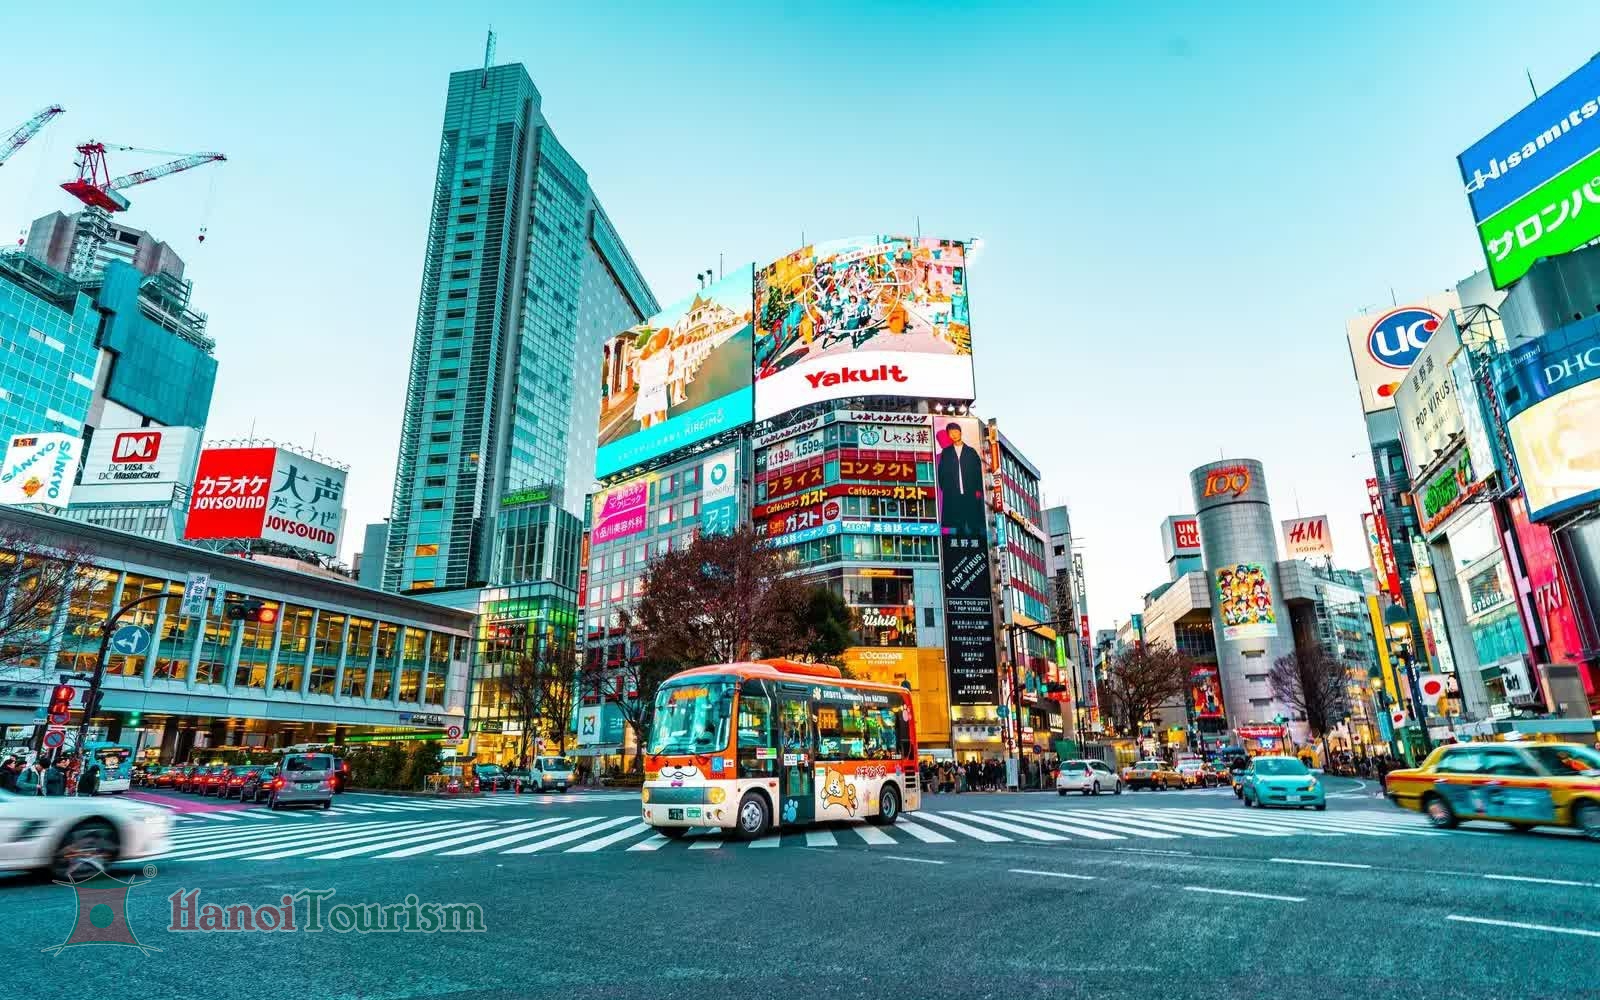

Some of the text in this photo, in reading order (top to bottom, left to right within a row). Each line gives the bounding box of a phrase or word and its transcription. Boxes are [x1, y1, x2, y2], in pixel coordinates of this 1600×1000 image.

[1465, 95, 1600, 195] Hisamits
[804, 364, 909, 389] Yakult
[1544, 346, 1600, 385] DHC
[116, 435, 155, 458] DC
[883, 429, 929, 444] しゃぶ葉
[2, 442, 55, 484] SANKYO
[48, 441, 71, 498] SANKYO
[123, 463, 143, 471] VISA
[756, 455, 767, 466] 9F
[841, 461, 914, 477] コンタクト
[113, 471, 161, 480] MasterCard
[197, 475, 268, 496] カラオケ
[273, 464, 343, 504] 大声
[1203, 471, 1250, 498] 109
[193, 495, 266, 510] JOYSOUND
[799, 489, 828, 507] ガスト
[894, 486, 928, 499] ガスト
[265, 515, 336, 545] JOYSOUND
[785, 510, 820, 533] ガスト
[1289, 519, 1323, 544] H&M
